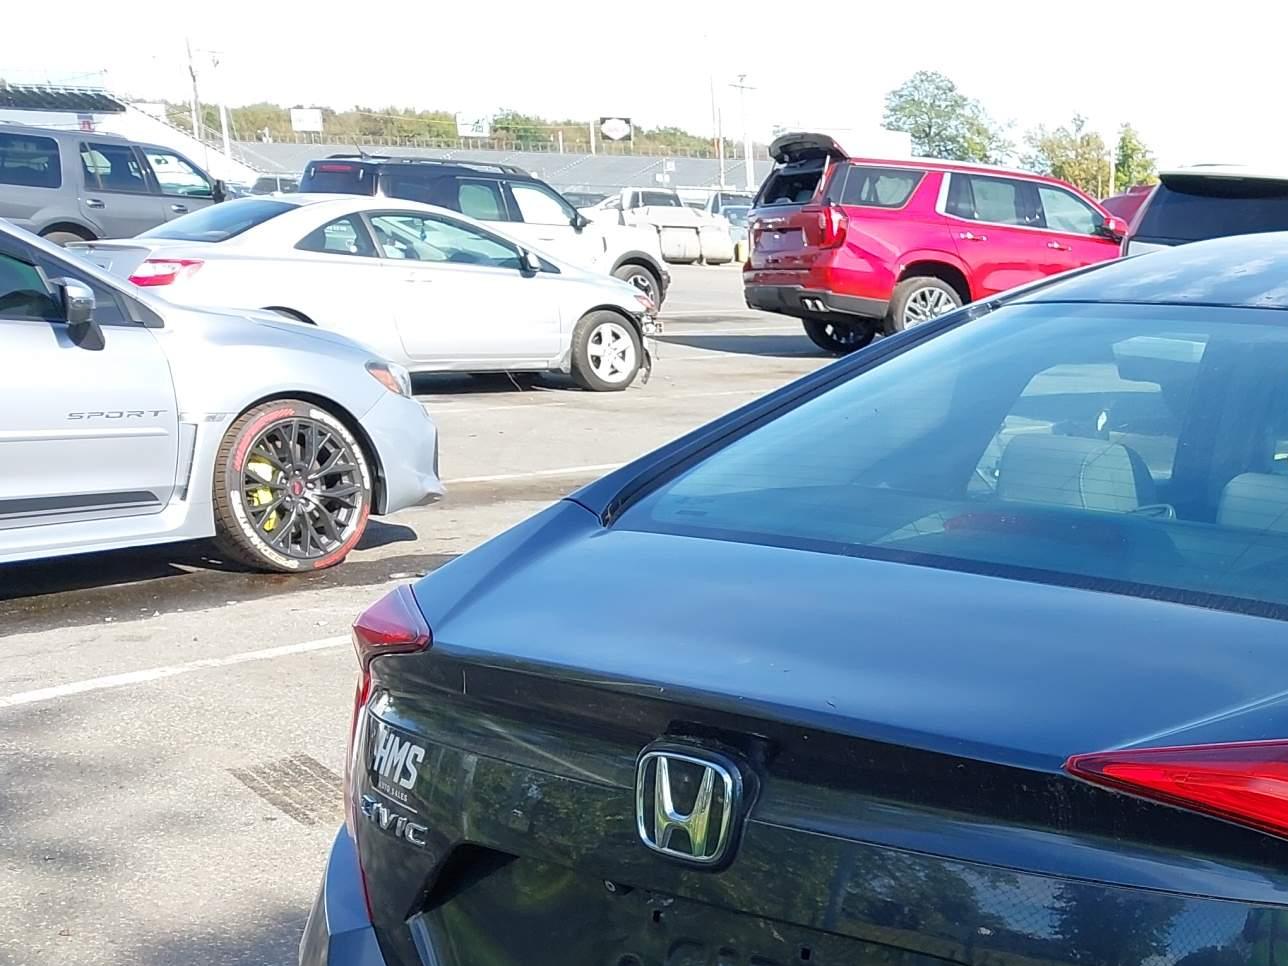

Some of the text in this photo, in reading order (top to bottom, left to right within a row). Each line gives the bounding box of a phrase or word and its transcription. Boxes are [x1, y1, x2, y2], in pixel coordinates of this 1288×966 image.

[67, 410, 169, 421] SPORT
[373, 730, 426, 790] HMS
[377, 780, 409, 803] AUTO SALES
[361, 794, 429, 847] CIVIC
